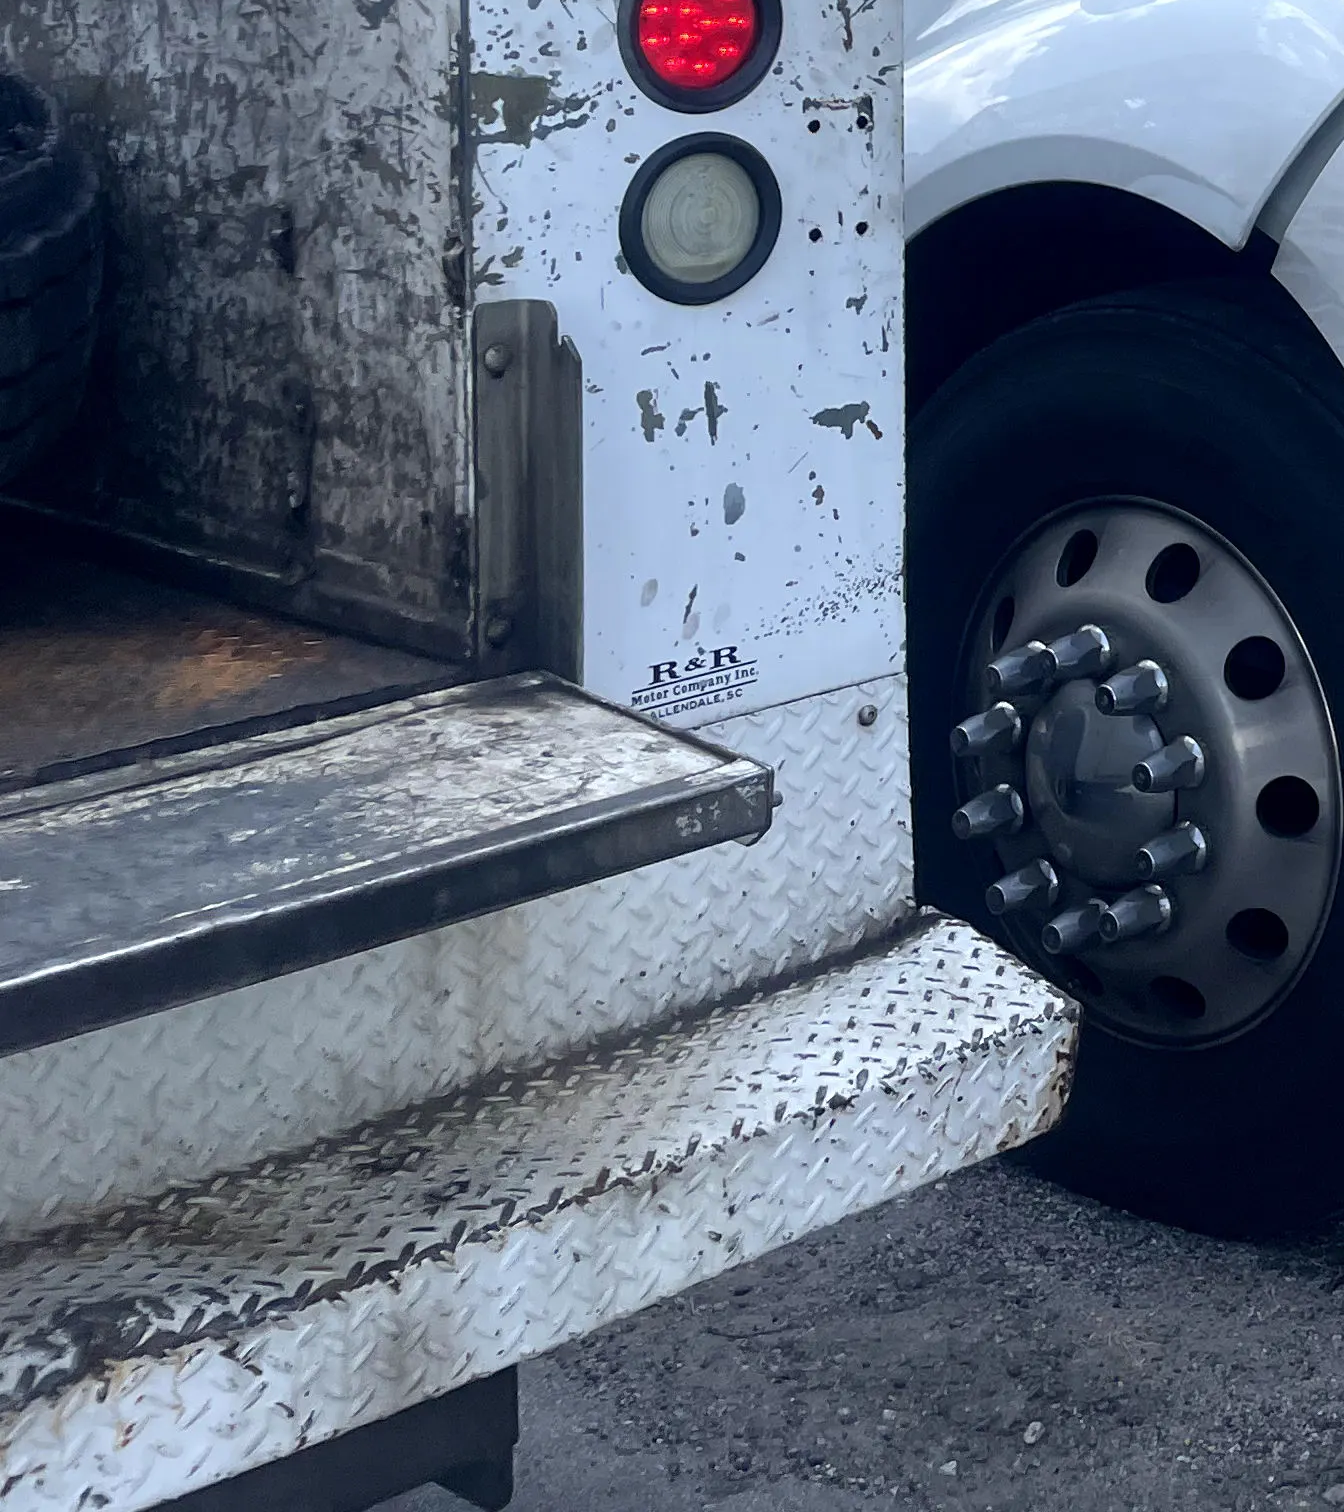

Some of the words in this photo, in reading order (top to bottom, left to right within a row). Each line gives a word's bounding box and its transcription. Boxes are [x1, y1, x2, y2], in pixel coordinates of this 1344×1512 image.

[631, 689, 669, 707] Motor
[673, 672, 731, 696] Company
[735, 667, 759, 680] Inc.
[727, 688, 743, 700] SC
